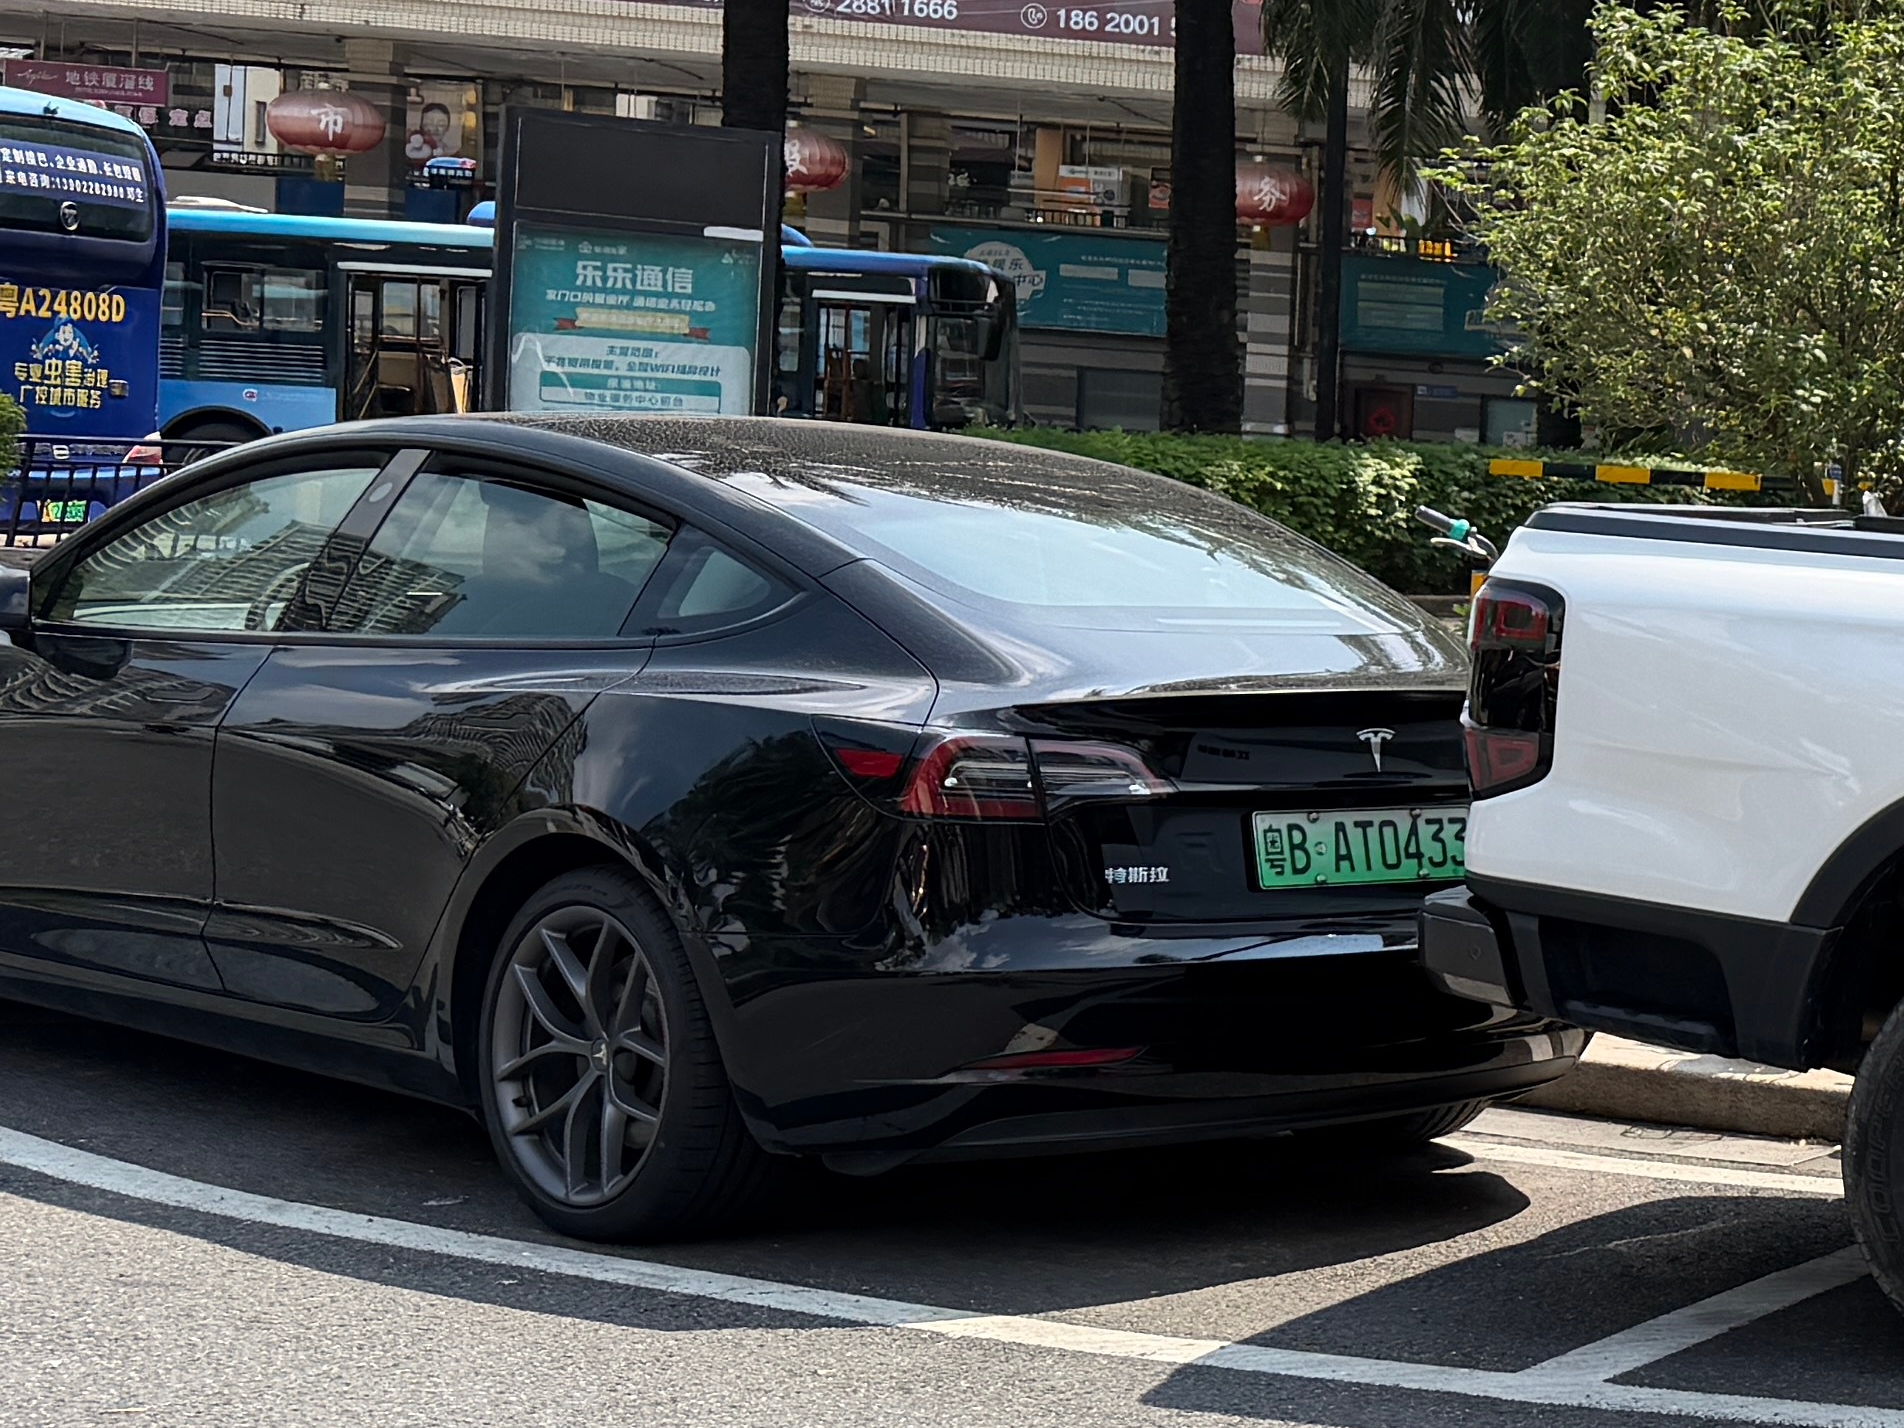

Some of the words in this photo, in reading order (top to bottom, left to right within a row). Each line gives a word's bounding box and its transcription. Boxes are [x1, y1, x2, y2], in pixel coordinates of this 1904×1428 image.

[311, 103, 349, 142] 市
[1254, 176, 1290, 212] 务
[574, 260, 695, 294] 乐乐通信
[0, 282, 126, 323] 粤A24808D
[1104, 865, 1171, 885] 特斯拉
